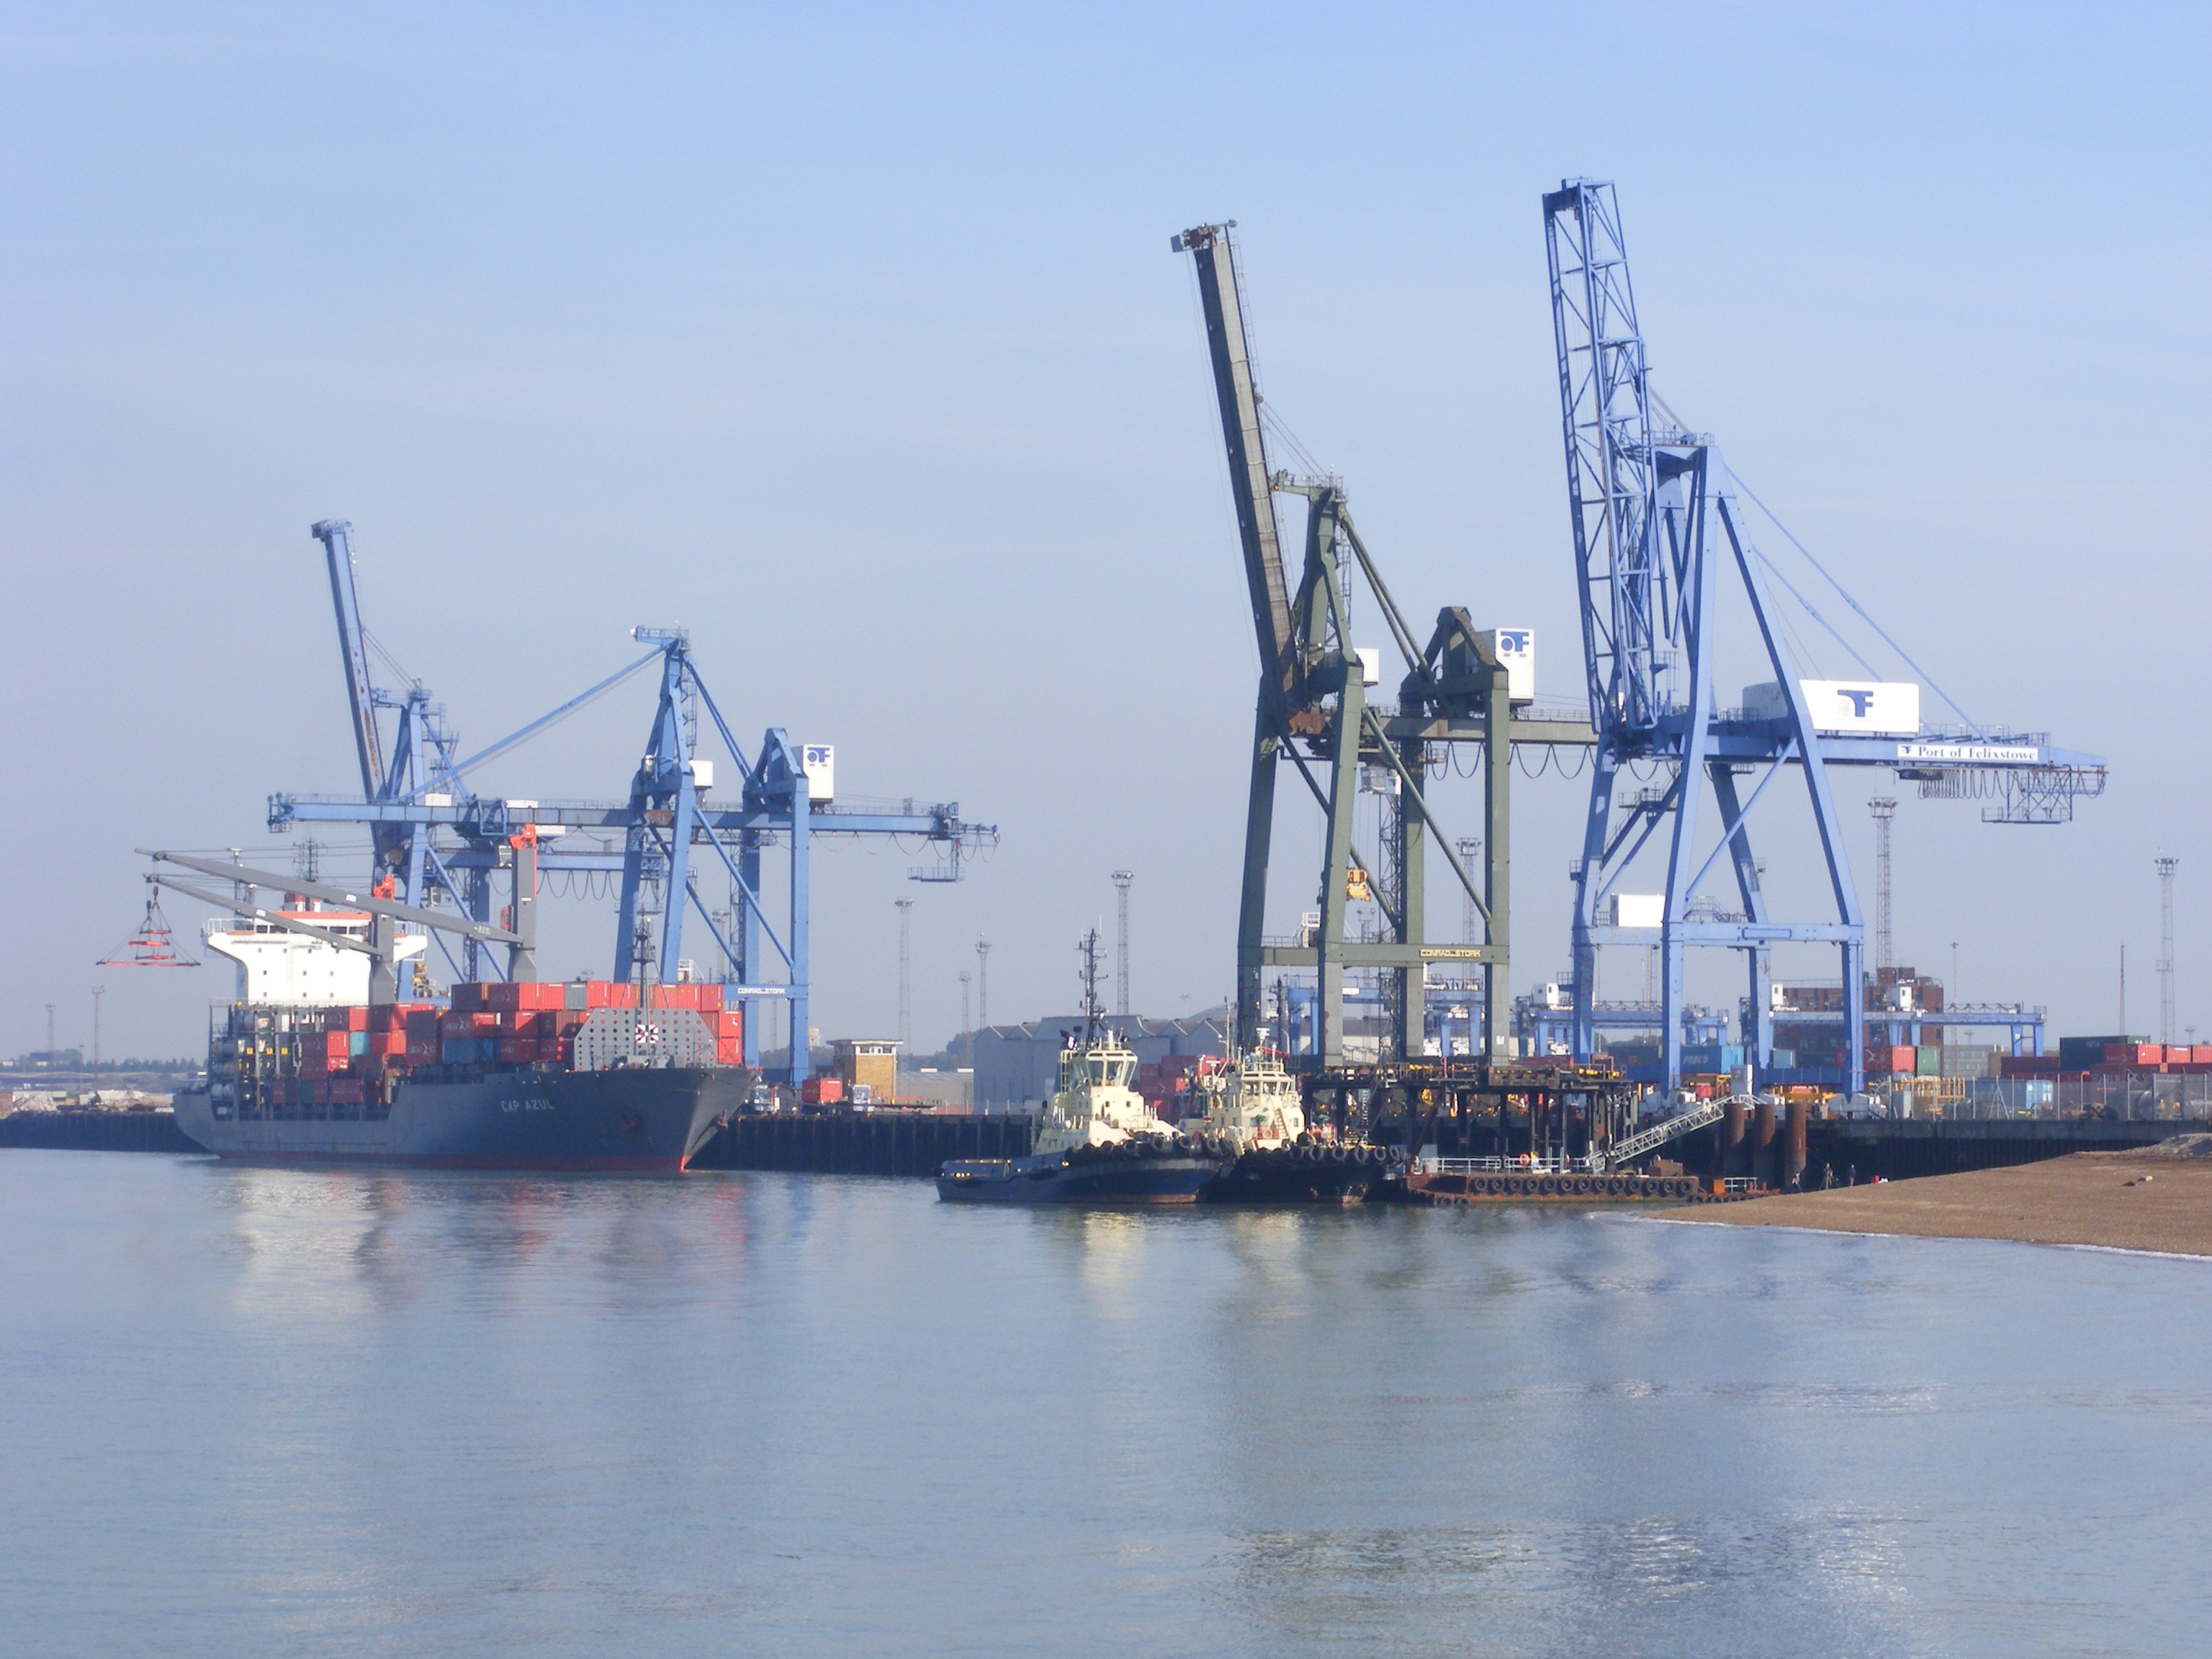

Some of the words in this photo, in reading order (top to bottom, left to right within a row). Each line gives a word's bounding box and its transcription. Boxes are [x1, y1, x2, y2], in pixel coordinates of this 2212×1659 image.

[1918, 746, 1944, 757] Port
[1950, 747, 1963, 758] of
[1969, 747, 2038, 760] Felixstowe
[500, 1100, 518, 1112] CAP
[525, 1099, 555, 1110] AZUL
